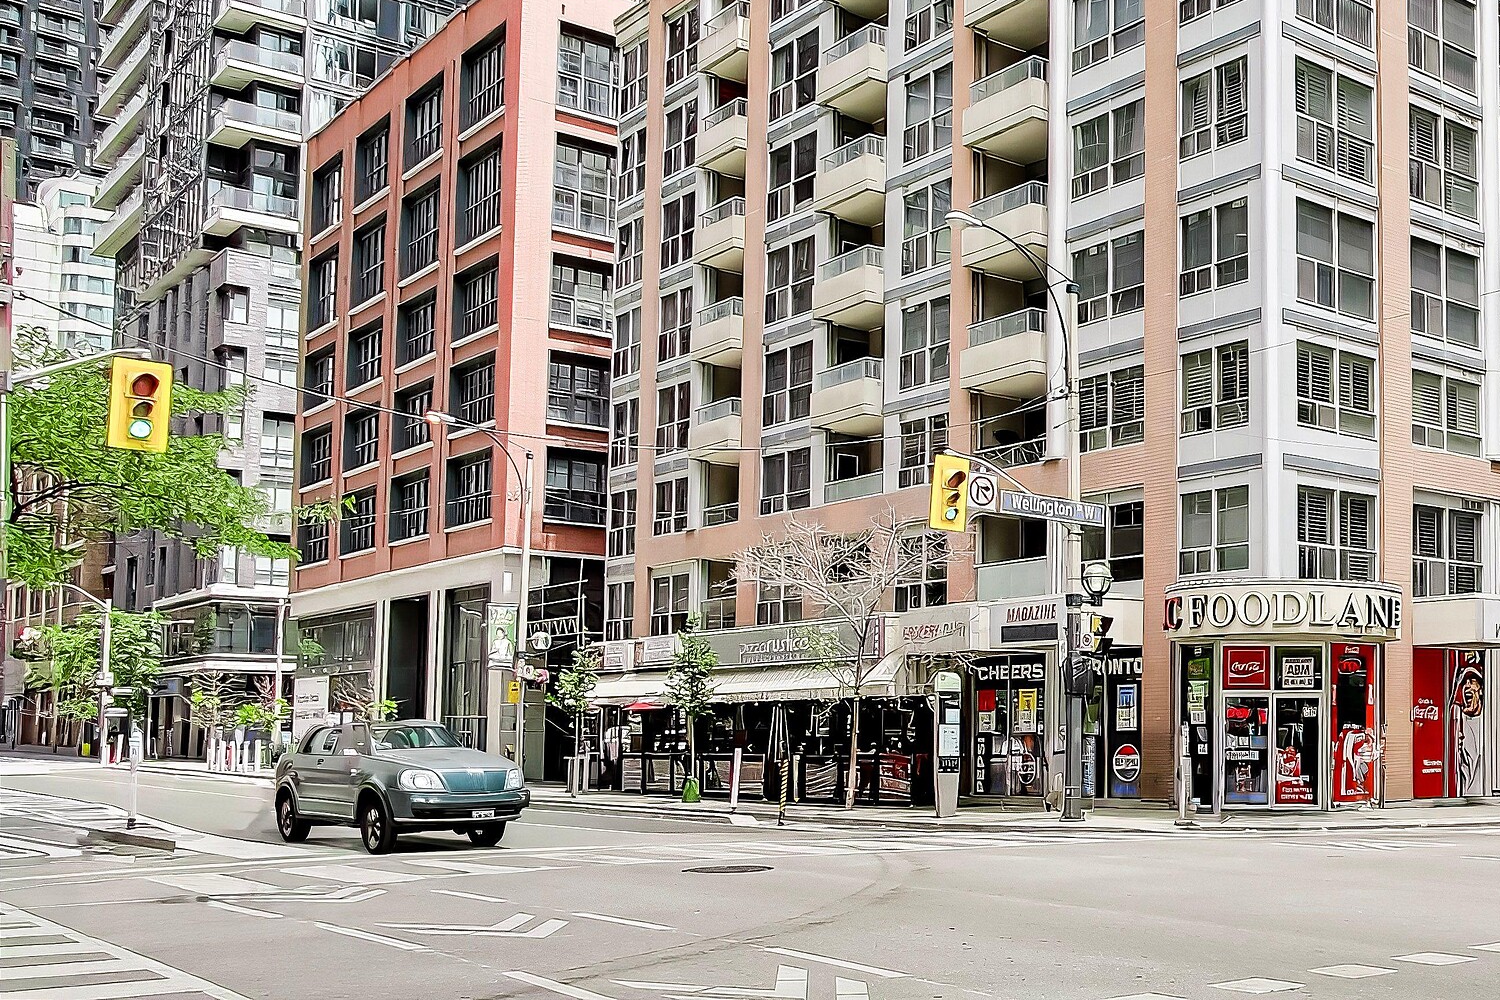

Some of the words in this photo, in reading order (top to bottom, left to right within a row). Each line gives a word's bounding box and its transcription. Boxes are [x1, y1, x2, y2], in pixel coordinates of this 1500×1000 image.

[1011, 493, 1073, 517] Wellington
[977, 663, 1044, 681] CHEERS
[1091, 657, 1143, 676] RONTO
